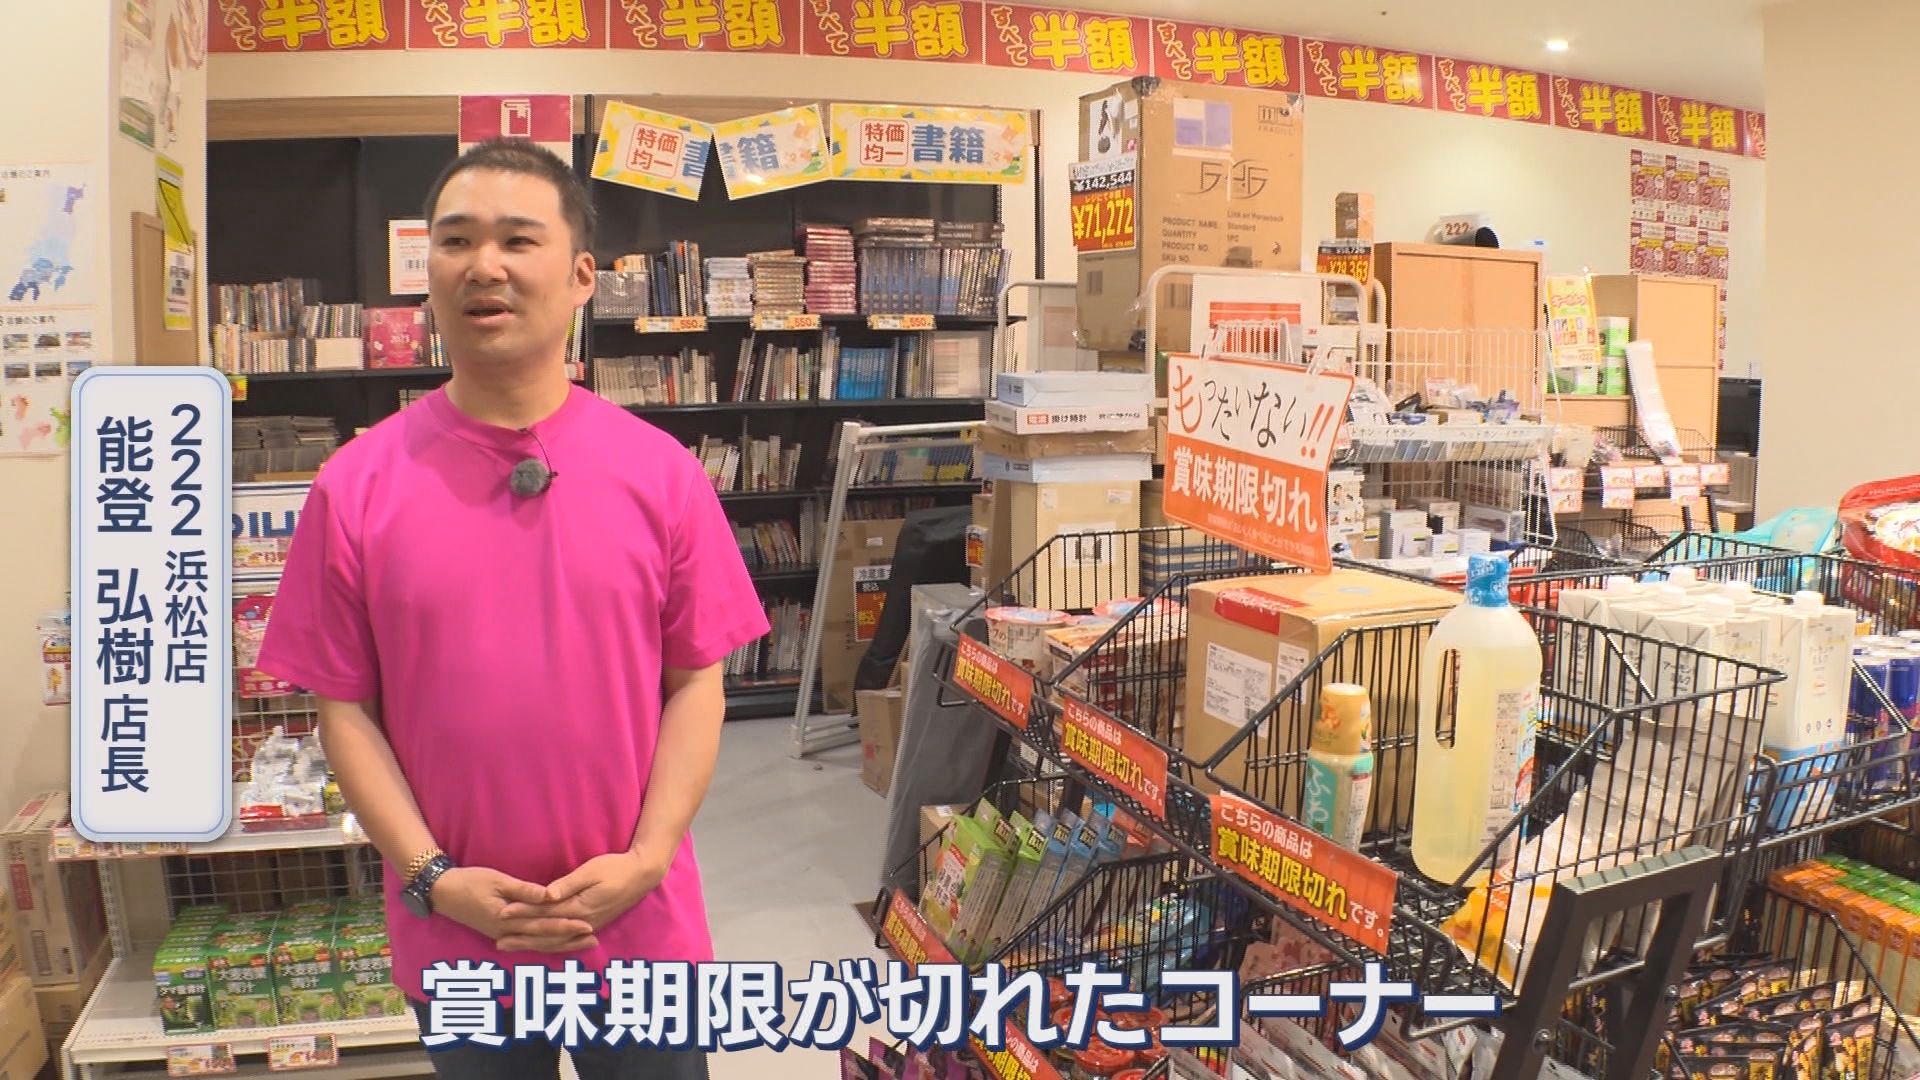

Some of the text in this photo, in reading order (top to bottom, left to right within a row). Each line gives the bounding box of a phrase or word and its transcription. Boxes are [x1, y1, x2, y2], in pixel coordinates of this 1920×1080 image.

[258, 0, 390, 50] 半額
[461, 0, 592, 48] 半額
[660, 0, 786, 50] 半額
[852, 0, 968, 60] 半額
[1030, 10, 1138, 72] 半額
[1193, 28, 1290, 88] 半額
[1338, 47, 1424, 103] 半額
[1466, 63, 1543, 119] 半額
[1579, 82, 1646, 136] 半額
[636, 127, 680, 153] 特価
[864, 122, 905, 143] 特価
[911, 124, 986, 164] 書籍
[1679, 99, 1738, 149] 半額
[630, 147, 674, 171] 均一
[864, 144, 904, 164] 均一
[1073, 170, 1133, 192] ¥142,544
[1072, 197, 1134, 248] ¥71,272
[1161, 240, 1195, 251] PRODUCT
[1162, 216, 1196, 226] PRODUCT
[1171, 445, 1318, 533] 賞味期限切れ
[1068, 703, 1122, 746] こちらの商品は
[1064, 721, 1163, 806] 賞味期限切れです。
[1220, 803, 1314, 860] こちらの商品は
[1216, 826, 1384, 938] 賞味期限切れです。
